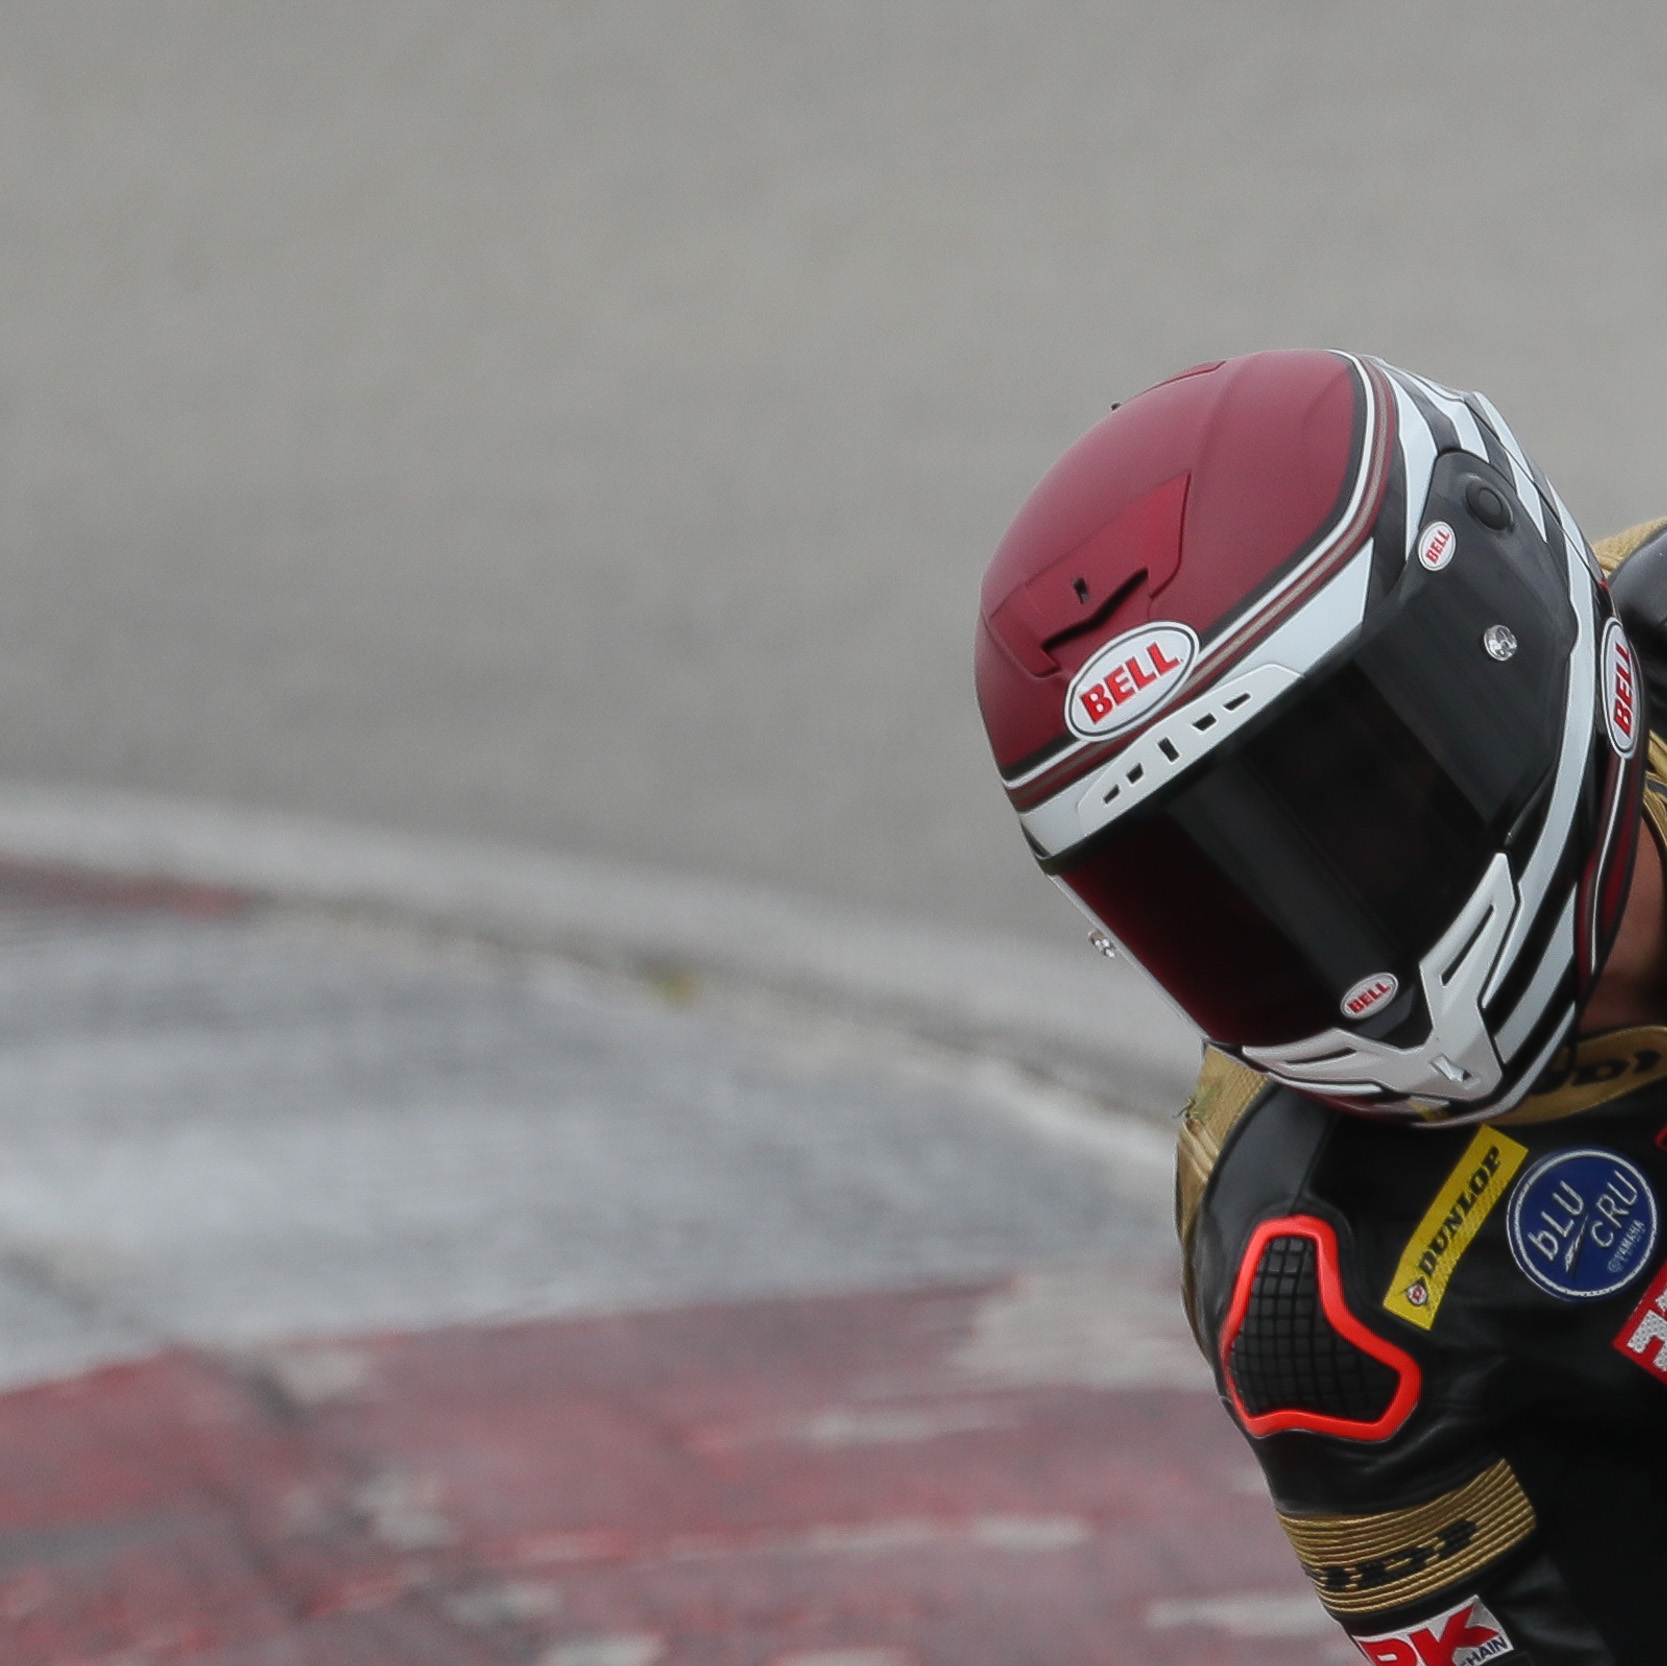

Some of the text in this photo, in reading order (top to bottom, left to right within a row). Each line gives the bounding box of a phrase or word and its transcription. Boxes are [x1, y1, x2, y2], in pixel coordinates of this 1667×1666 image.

[1425, 528, 1452, 566] BELL
[1079, 642, 1182, 726] BELL
[1612, 640, 1634, 738] BELL
[1347, 988, 1391, 1016] BELL
[1417, 1145, 1502, 1282] DUNLOP
